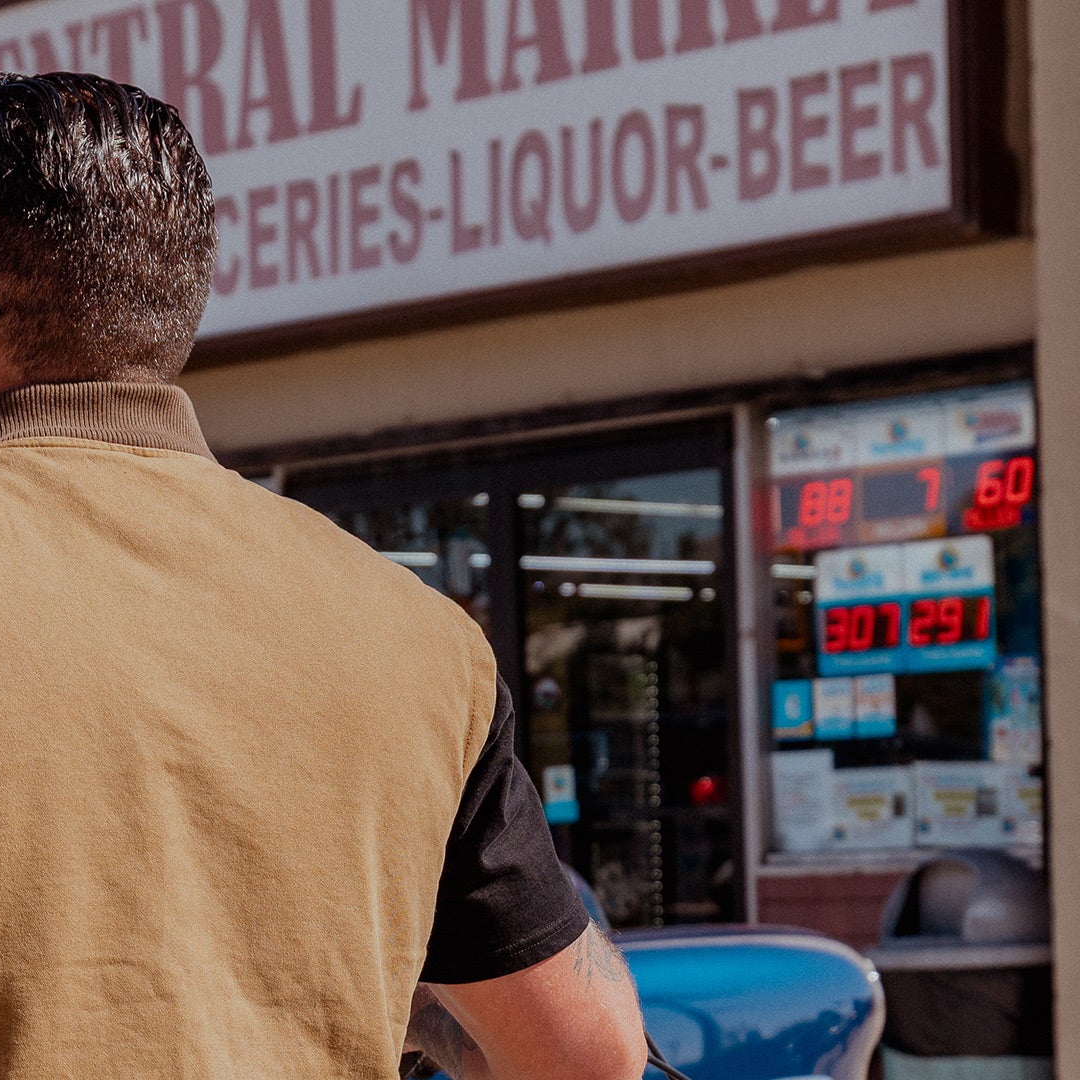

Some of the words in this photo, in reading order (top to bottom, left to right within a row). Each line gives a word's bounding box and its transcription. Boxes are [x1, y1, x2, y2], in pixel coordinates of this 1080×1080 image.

[799, 479, 853, 526] 88
[974, 456, 1035, 509] 60
[822, 602, 901, 654] 307
[908, 596, 991, 648] 291
